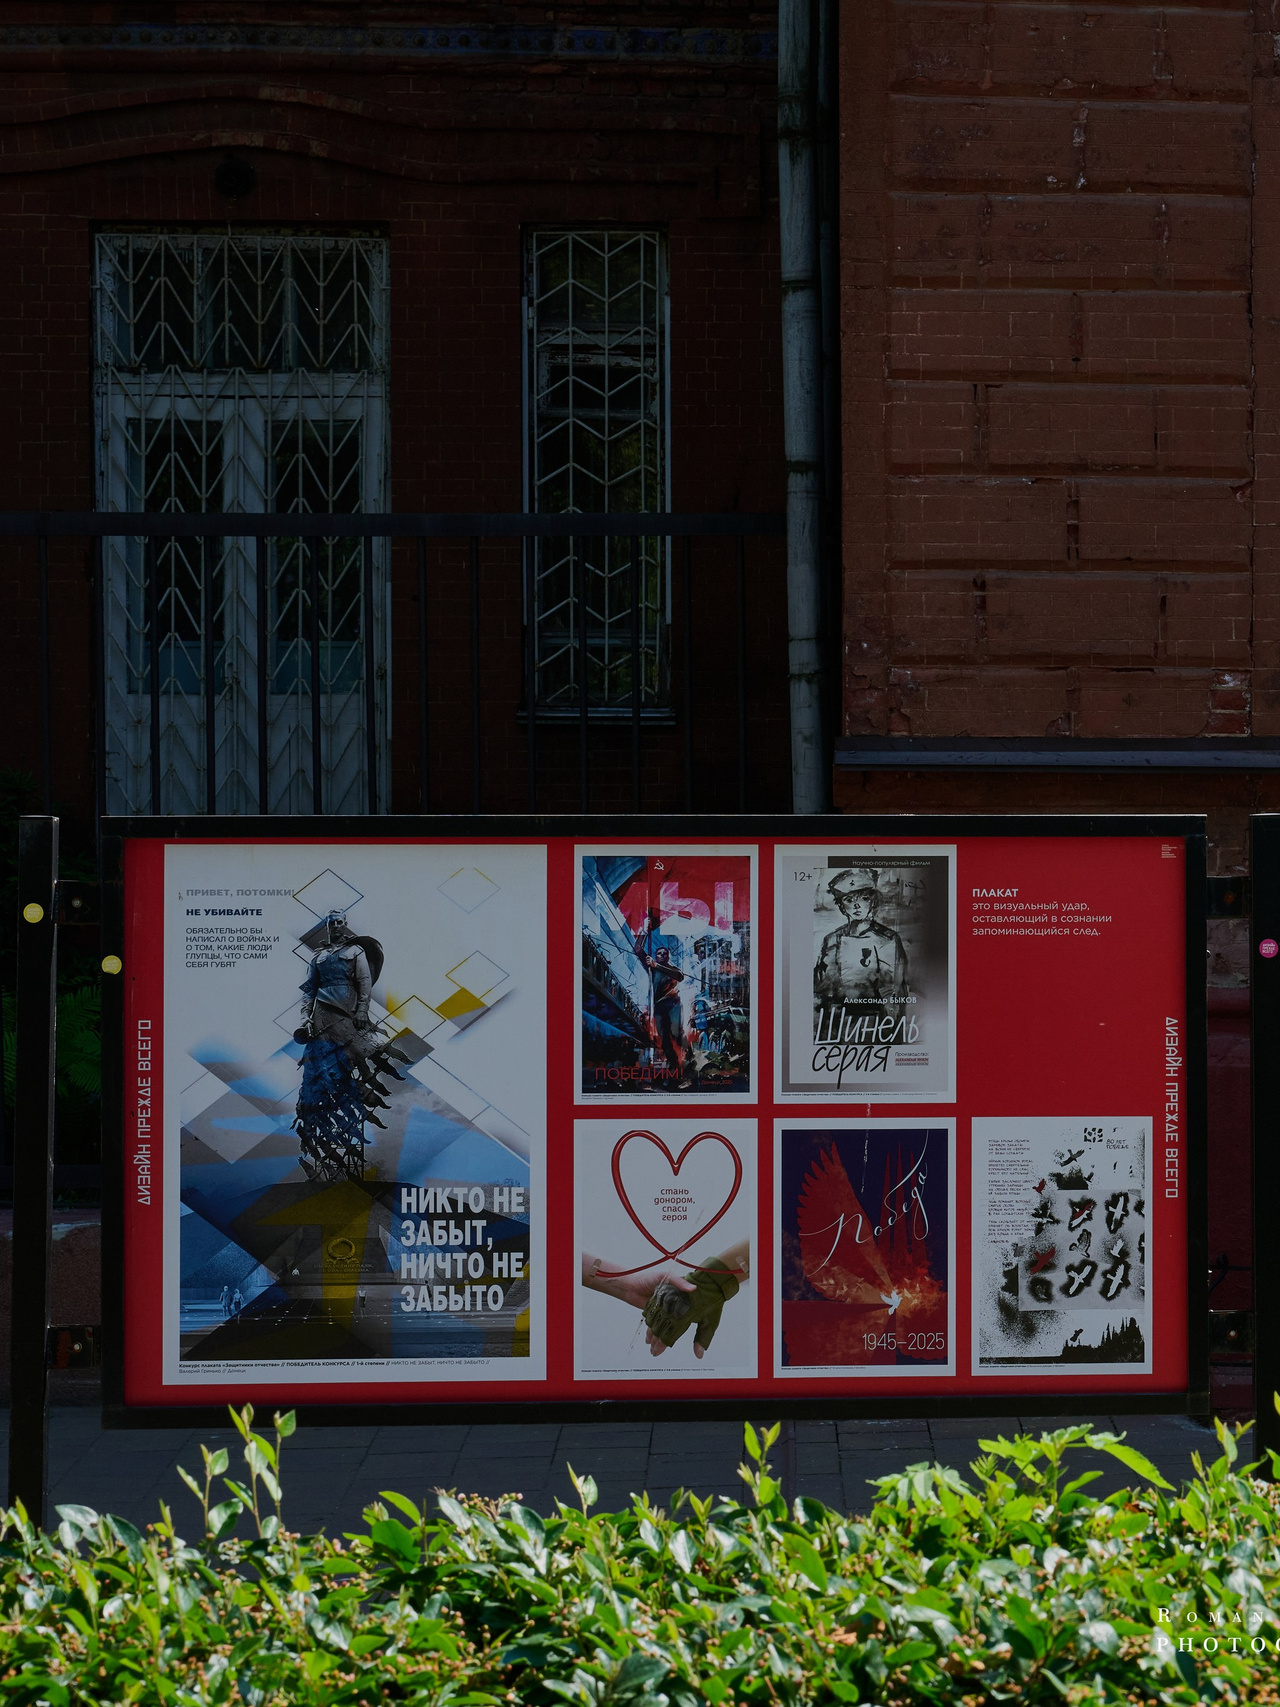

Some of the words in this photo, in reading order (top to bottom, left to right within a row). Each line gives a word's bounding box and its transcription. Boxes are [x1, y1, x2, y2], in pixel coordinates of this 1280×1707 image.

[793, 871, 812, 882] 12+
[186, 889, 233, 897] ПРИВЕТ,
[236, 889, 295, 897] ПОТОМКИ!
[973, 888, 1018, 898] ПЛАКАТ
[204, 907, 263, 916] УБИВАЙТЕ
[594, 881, 733, 936] МЫ
[972, 902, 990, 910] это
[993, 901, 1058, 910] визуальный
[1061, 902, 1090, 912] удар,
[972, 913, 1048, 924] оставляющий
[972, 926, 1070, 937] запоминающийся
[1073, 927, 1101, 936] след.
[247, 944, 273, 952] ЛЮДИ
[843, 996, 888, 1006] Александр
[889, 996, 916, 1004] БЫКОВ
[815, 1007, 920, 1045] Шинель
[137, 1019, 152, 1070] ВСЕГО
[1165, 1017, 1182, 1077] ДИЗАЙН
[594, 1067, 684, 1083] ПОБЕДИМ!
[812, 1044, 890, 1090] серая
[137, 1078, 152, 1139] ПРЕЖДЕ
[1165, 1083, 1179, 1144] ПРЕЖДЕ
[133, 1143, 152, 1206] ДИЗАЙН
[1165, 1149, 1179, 1198] ВСЕГО
[401, 1187, 485, 1213] НИКТО
[493, 1187, 525, 1213] НЕ
[654, 1196, 696, 1206] донором,
[660, 1187, 689, 1196] стань
[661, 1213, 687, 1222] героя
[401, 1220, 493, 1251] ЗАБЫТ,
[401, 1252, 485, 1279] НИЧТО
[492, 1252, 524, 1278] НЕ
[401, 1285, 504, 1312] ЗАБЫТО
